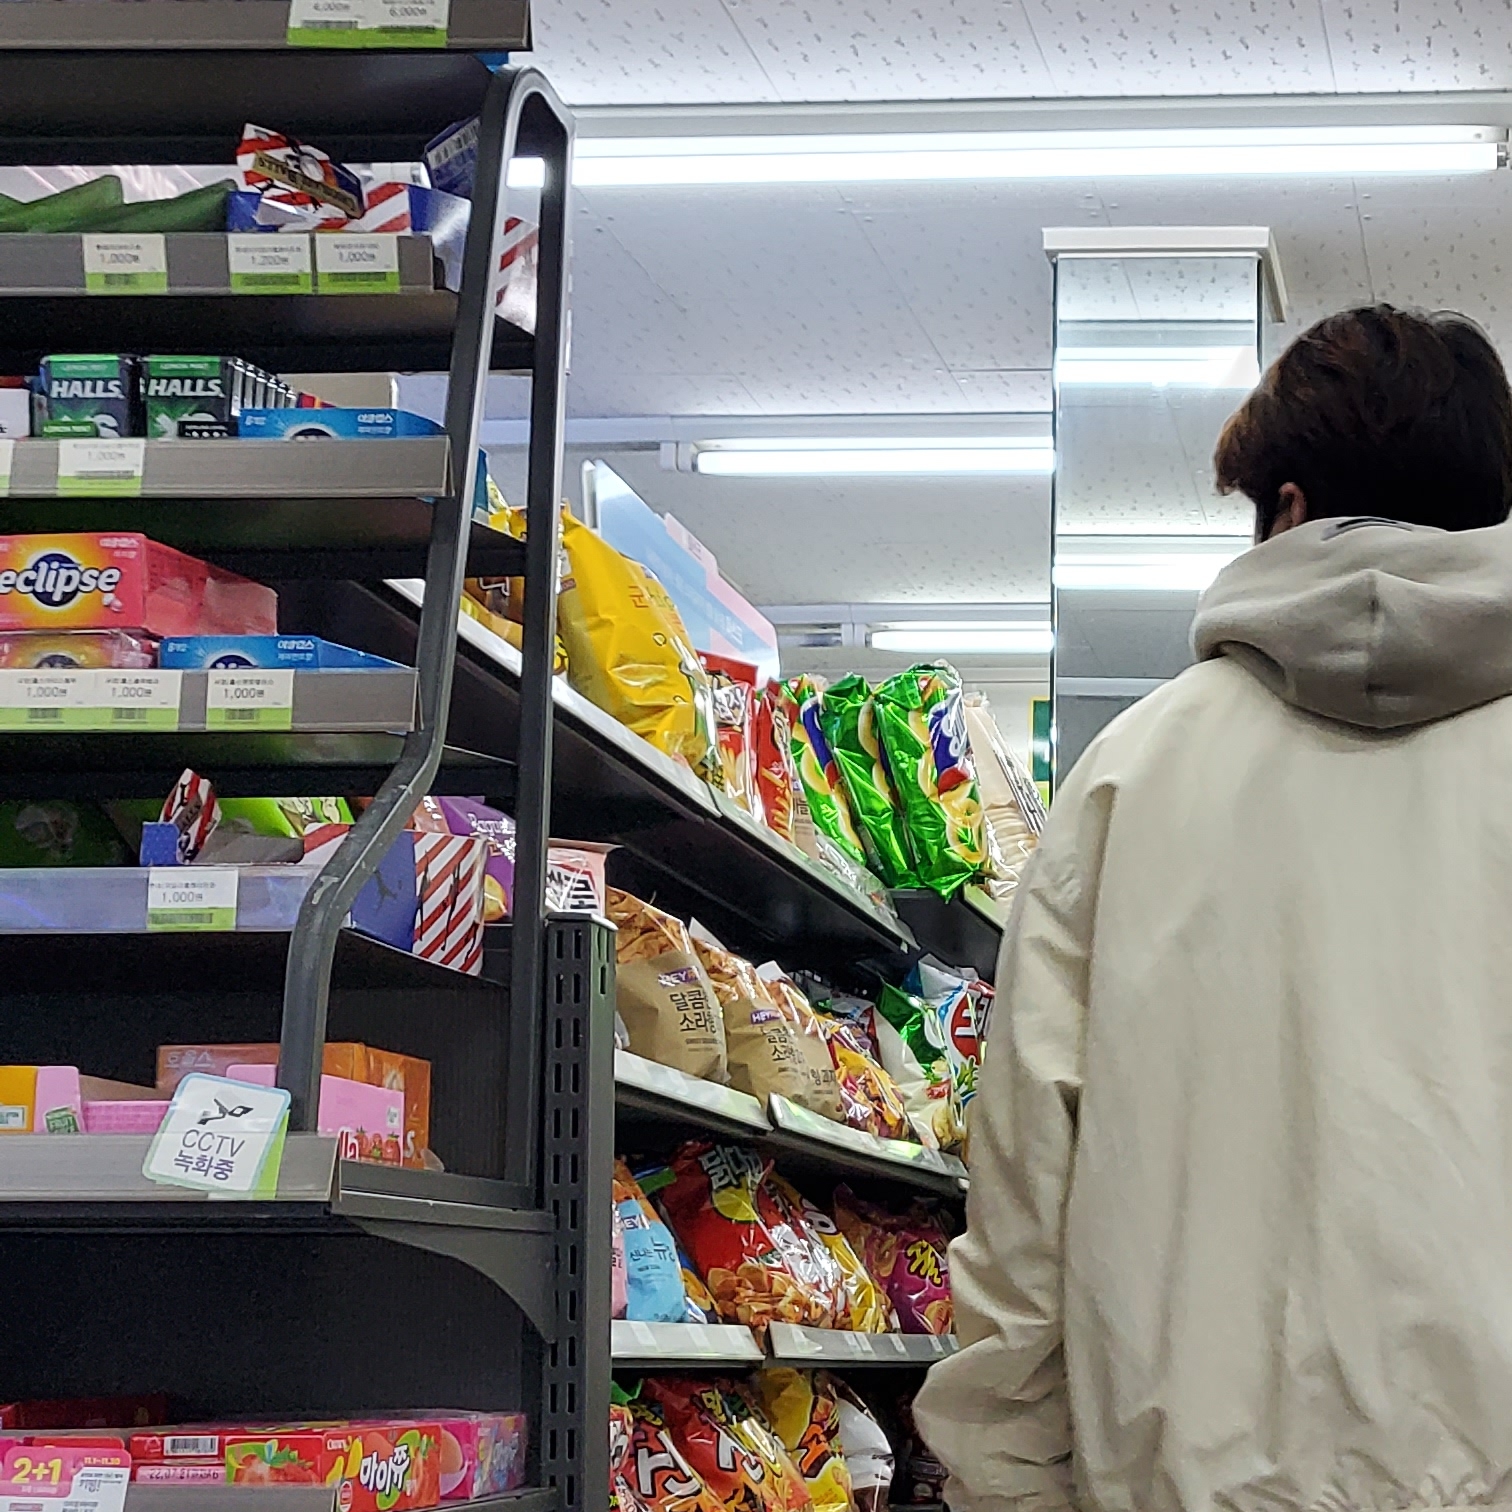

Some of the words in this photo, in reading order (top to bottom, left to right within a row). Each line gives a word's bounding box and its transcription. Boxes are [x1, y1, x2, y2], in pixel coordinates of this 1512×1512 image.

[51, 380, 122, 399] HALLS
[148, 379, 222, 397] HALLS
[0, 561, 121, 602] eclipse
[223, 688, 265, 699] 1,000원
[181, 1128, 245, 1158] CCTV
[173, 1149, 235, 1181] 녹화중
[12, 1456, 63, 1486] 2+1
[360, 1443, 410, 1496] 마이쮸
